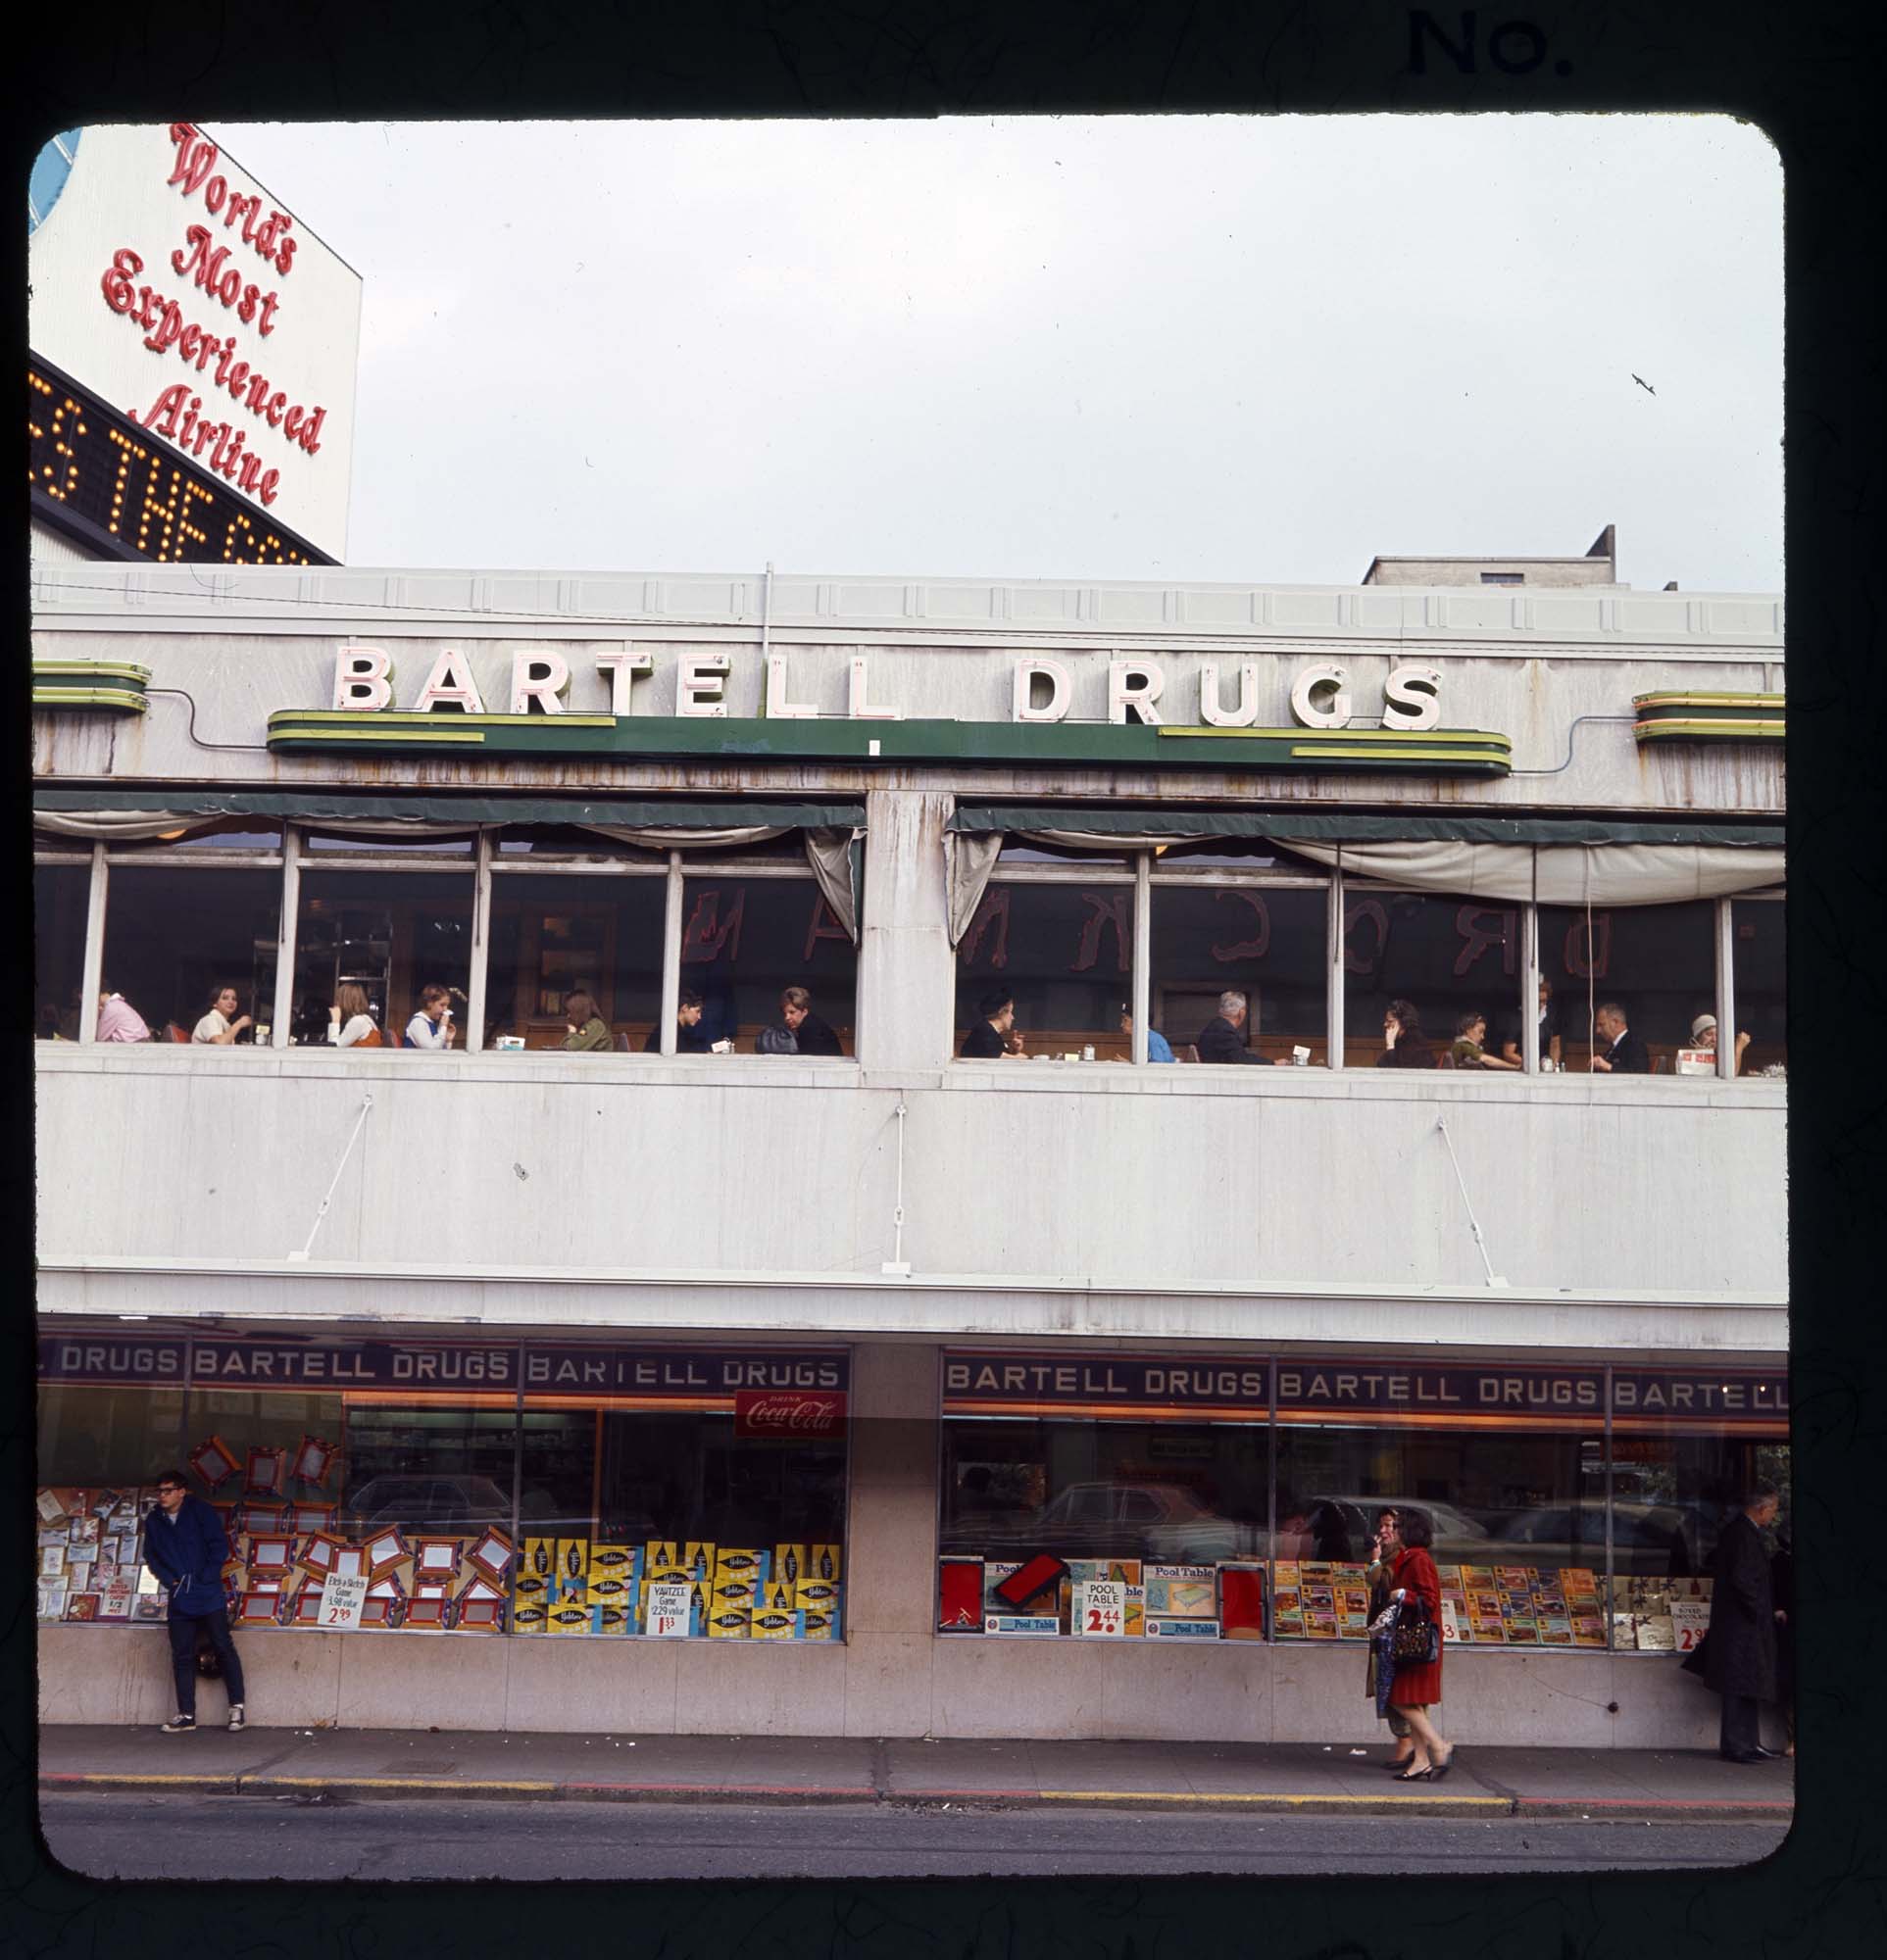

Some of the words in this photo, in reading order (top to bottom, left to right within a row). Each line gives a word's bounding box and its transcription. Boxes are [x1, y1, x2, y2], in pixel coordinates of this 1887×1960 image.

[1409, 10, 1572, 74] No.
[172, 224, 279, 338] Most
[101, 248, 326, 455] Experienced
[127, 384, 279, 506] Airline
[334, 647, 902, 721] BARTELL
[1013, 657, 1443, 731] DRUGS
[61, 1345, 177, 1373] DRUGS
[196, 1348, 375, 1378] BARTELL
[392, 1351, 509, 1381] DRUGS
[723, 1360, 839, 1387] DRUGS
[947, 1364, 1127, 1393] BARTELL
[1145, 1370, 1263, 1397] DRUGS
[1279, 1372, 1461, 1401] BARTELL
[1479, 1378, 1597, 1405] DRUGS
[1614, 1382, 1789, 1409] BARTELL
[1155, 1567, 1180, 1577] Pool
[1181, 1567, 1215, 1578] Table
[1087, 1594, 1119, 1604] TABLE
[1090, 1585, 1117, 1594] POOL
